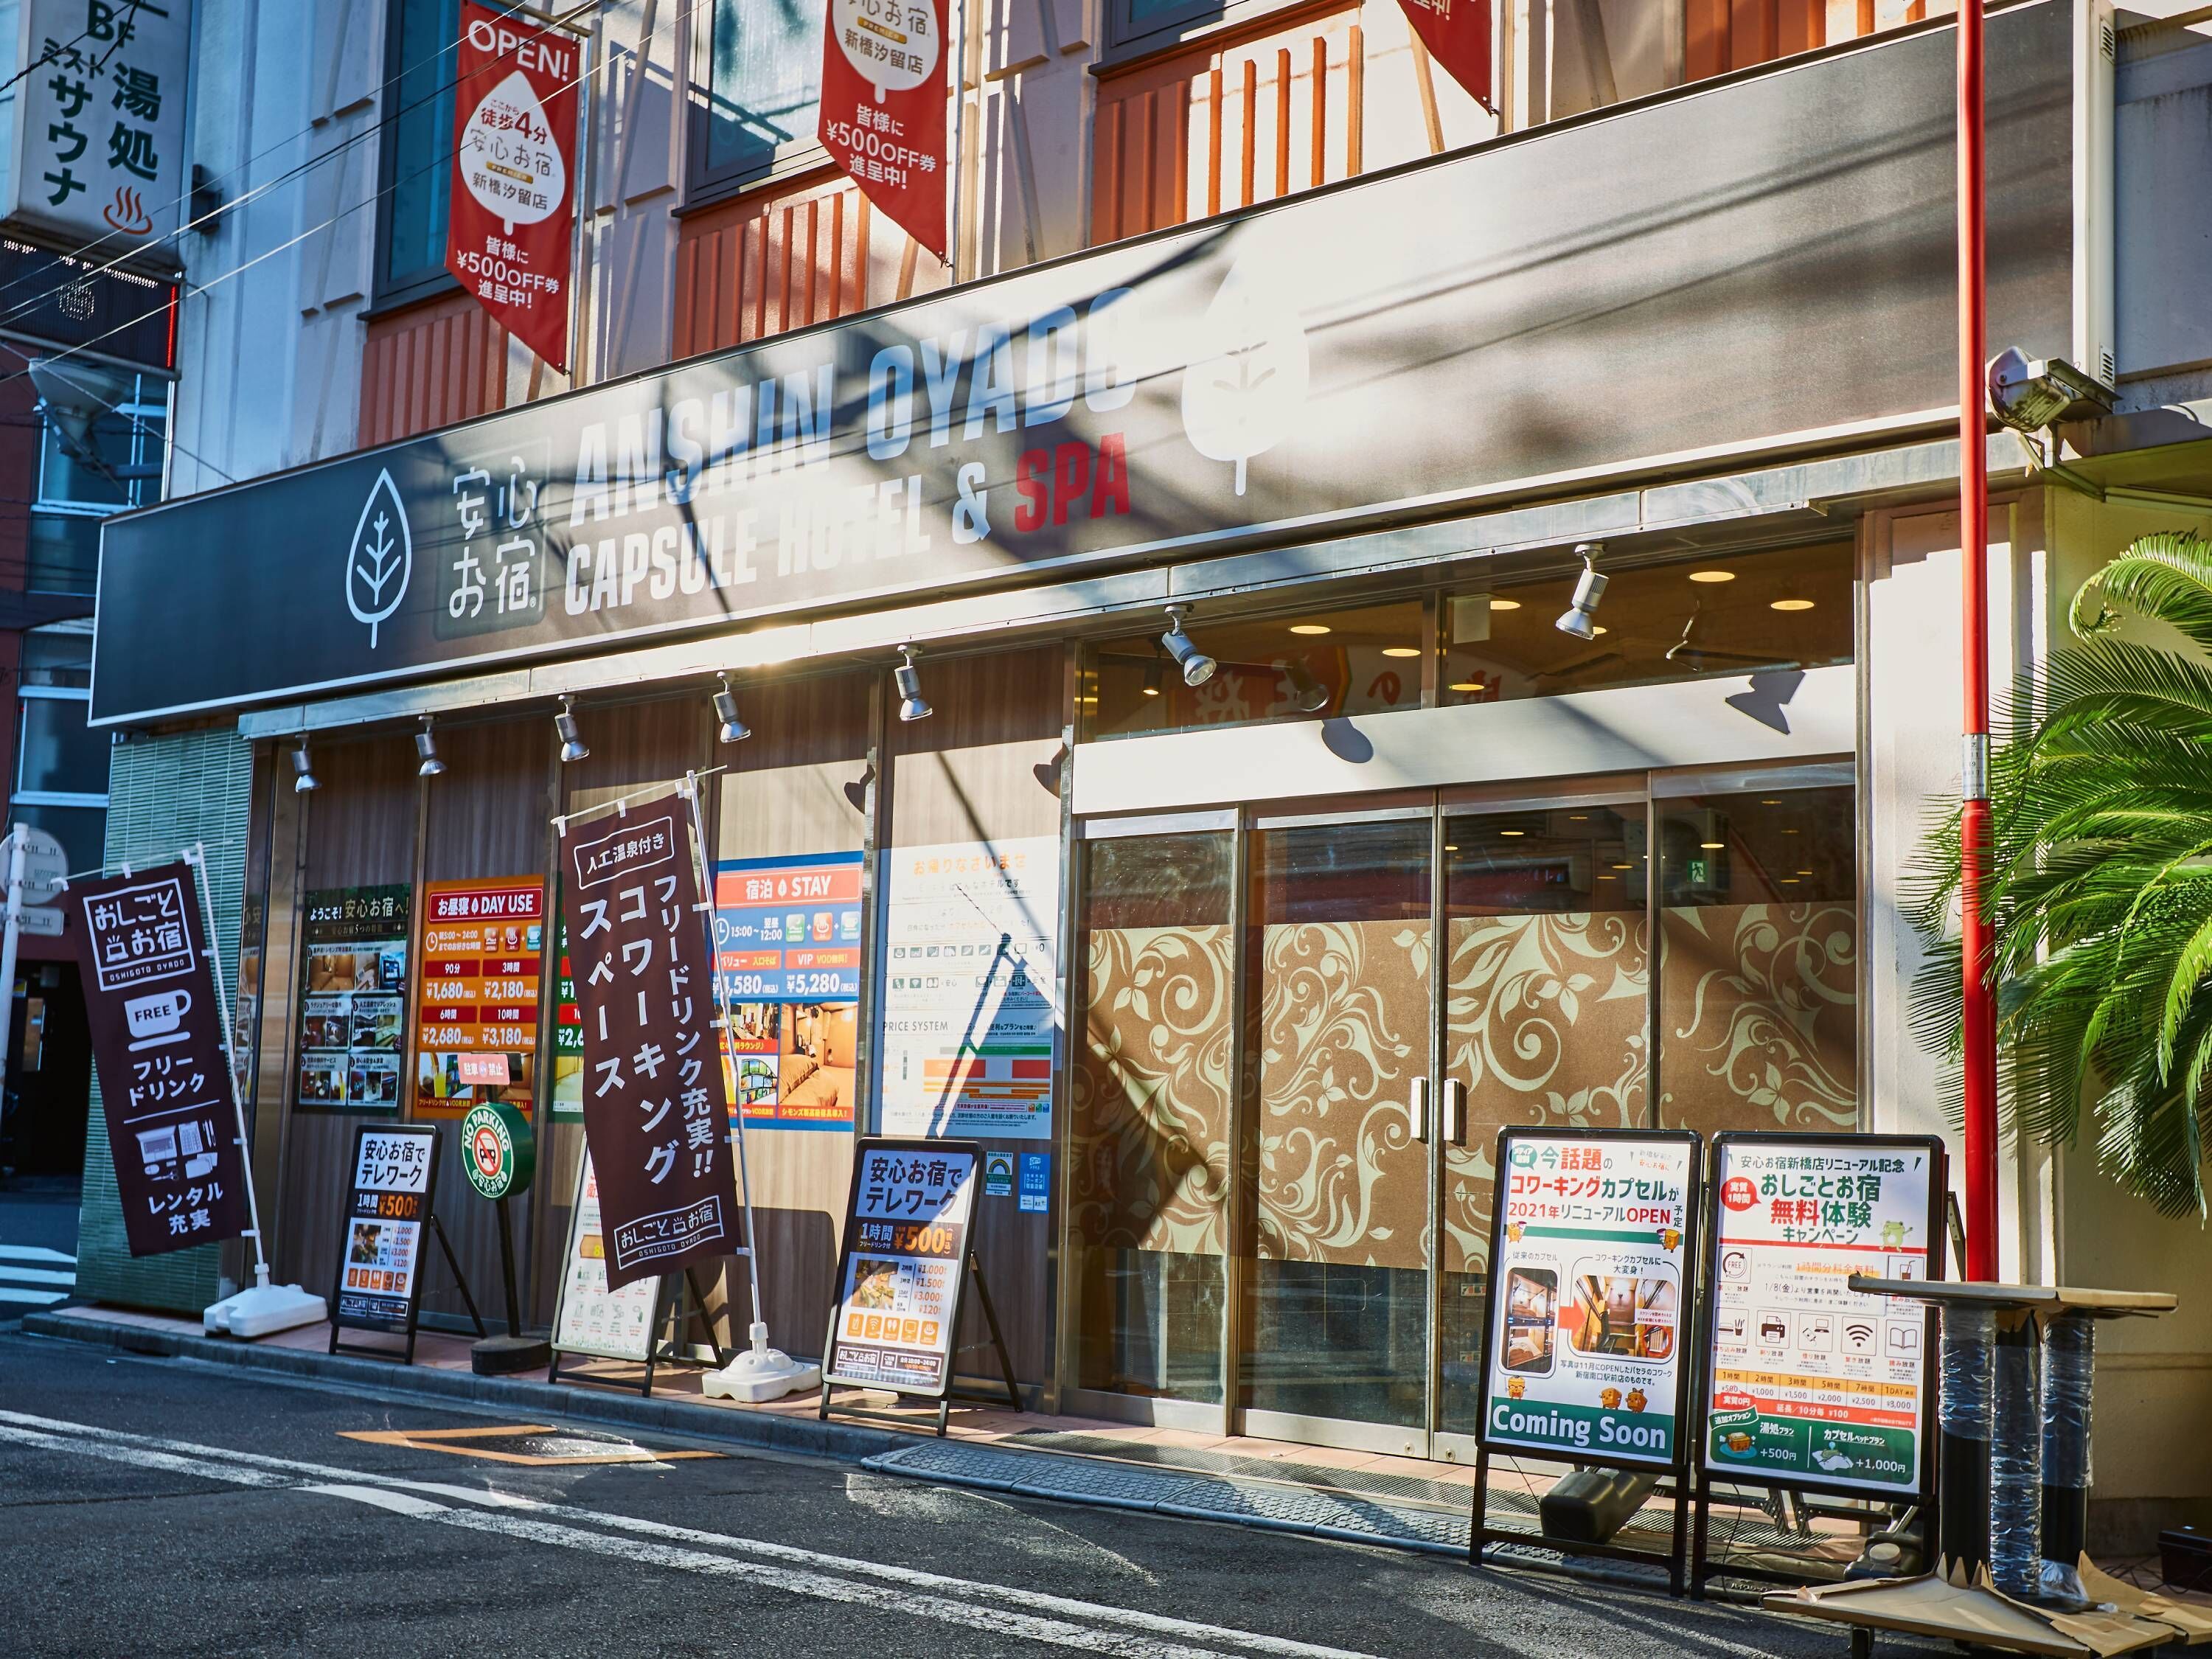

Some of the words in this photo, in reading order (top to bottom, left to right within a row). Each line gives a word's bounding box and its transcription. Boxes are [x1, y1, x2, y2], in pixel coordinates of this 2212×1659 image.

[849, 0, 929, 35] 心お宿
[41, 38, 105, 80] ミスト
[468, 19, 569, 82] OPEN!
[845, 28, 924, 75] 新橋汐留店
[108, 62, 161, 182] 湯処
[481, 107, 548, 145] 徒歩4分
[856, 103, 905, 137] 皆様に
[44, 74, 93, 206] サウナ
[470, 128, 553, 177] 安心お宿
[473, 172, 548, 210] 新橋汐留店
[486, 235, 529, 264] 皆様に
[569, 364, 834, 528] ANSHIN
[867, 287, 1139, 461] OYADO
[565, 507, 758, 616] CAPSULE
[777, 474, 931, 577] HOTEL
[952, 462, 991, 544] &
[1015, 432, 1131, 532] SPA
[587, 833, 664, 874] 人工温泉付き
[745, 879, 773, 900] 宿泊
[791, 875, 832, 897] STAY
[95, 889, 179, 931] おしごと
[438, 897, 470, 917] お昼寝
[481, 895, 507, 914] DAY
[509, 894, 534, 914] USE
[131, 921, 183, 956] お宿
[731, 925, 752, 937] 15:00
[760, 929, 782, 941] 12:00
[109, 965, 152, 982] OSHIGOTO
[157, 959, 184, 972] OYADO
[445, 963, 461, 974] 90分
[502, 961, 521, 973] 3時間
[797, 953, 813, 966] VIP
[580, 899, 625, 1098] スペース
[134, 1004, 172, 1023] FREE
[440, 1009, 457, 1020] 6時間
[498, 1009, 520, 1020] 10時間
[883, 1021, 908, 1032] PRICE
[912, 1020, 948, 1032] SYSTEM
[620, 886, 680, 1185] コワーキング
[133, 1056, 193, 1081] フリー
[128, 1073, 206, 1107] ドリンク
[464, 1124, 475, 1150] NO
[471, 1110, 510, 1152] PARKING
[364, 1139, 425, 1163] 安心お宿で
[1540, 1145, 1613, 1171] 今話題の
[1741, 1155, 1905, 1173] 安心お宿新橋店リニューアル記念
[362, 1164, 422, 1188] テレワーク
[870, 1157, 963, 1189] 安心お宿で
[148, 1181, 224, 1215] レンタル
[1510, 1175, 1680, 1202] コワーキングカプセルが
[1728, 1194, 1751, 1205] 1時間
[1730, 1182, 1749, 1193] 実質
[1761, 1174, 1882, 1202] おしごとお宿
[357, 1193, 379, 1208] 1時間
[379, 1194, 413, 1217] ¥500
[866, 1187, 958, 1217] テレワーク
[1508, 1202, 1671, 1225] 2021年リニューアルOPEN
[1770, 1198, 1873, 1229] 無料体験
[169, 1208, 212, 1236] 充実
[1673, 1205, 1683, 1228] 予定
[622, 1219, 670, 1248] おしごと
[639, 1243, 676, 1257] OSHIGOTO
[681, 1234, 701, 1247] OYADO
[860, 1222, 894, 1242] 1時間
[894, 1226, 946, 1254] ¥500
[1782, 1225, 1859, 1245] キャンペーン
[1512, 1251, 1558, 1262] 従来のカプセル
[1595, 1253, 1661, 1265] コワーキングカプセルに
[1728, 1261, 1742, 1269] FREE
[1722, 1371, 1740, 1380] 1時間
[1755, 1374, 1773, 1383] 2時間
[1788, 1377, 1806, 1386] 3時間
[1822, 1380, 1840, 1390] 5時間
[1856, 1383, 1875, 1393] 7時間
[1885, 1386, 1904, 1395] 1DAY
[1722, 1395, 1750, 1406] 実質0円
[1492, 1404, 1590, 1447] Coming
[1599, 1416, 1666, 1450] Soon
[1759, 1422, 1794, 1435] 湯処プラン
[1760, 1449, 1797, 1461] +500円
[1855, 1459, 1906, 1473] +1,000円
